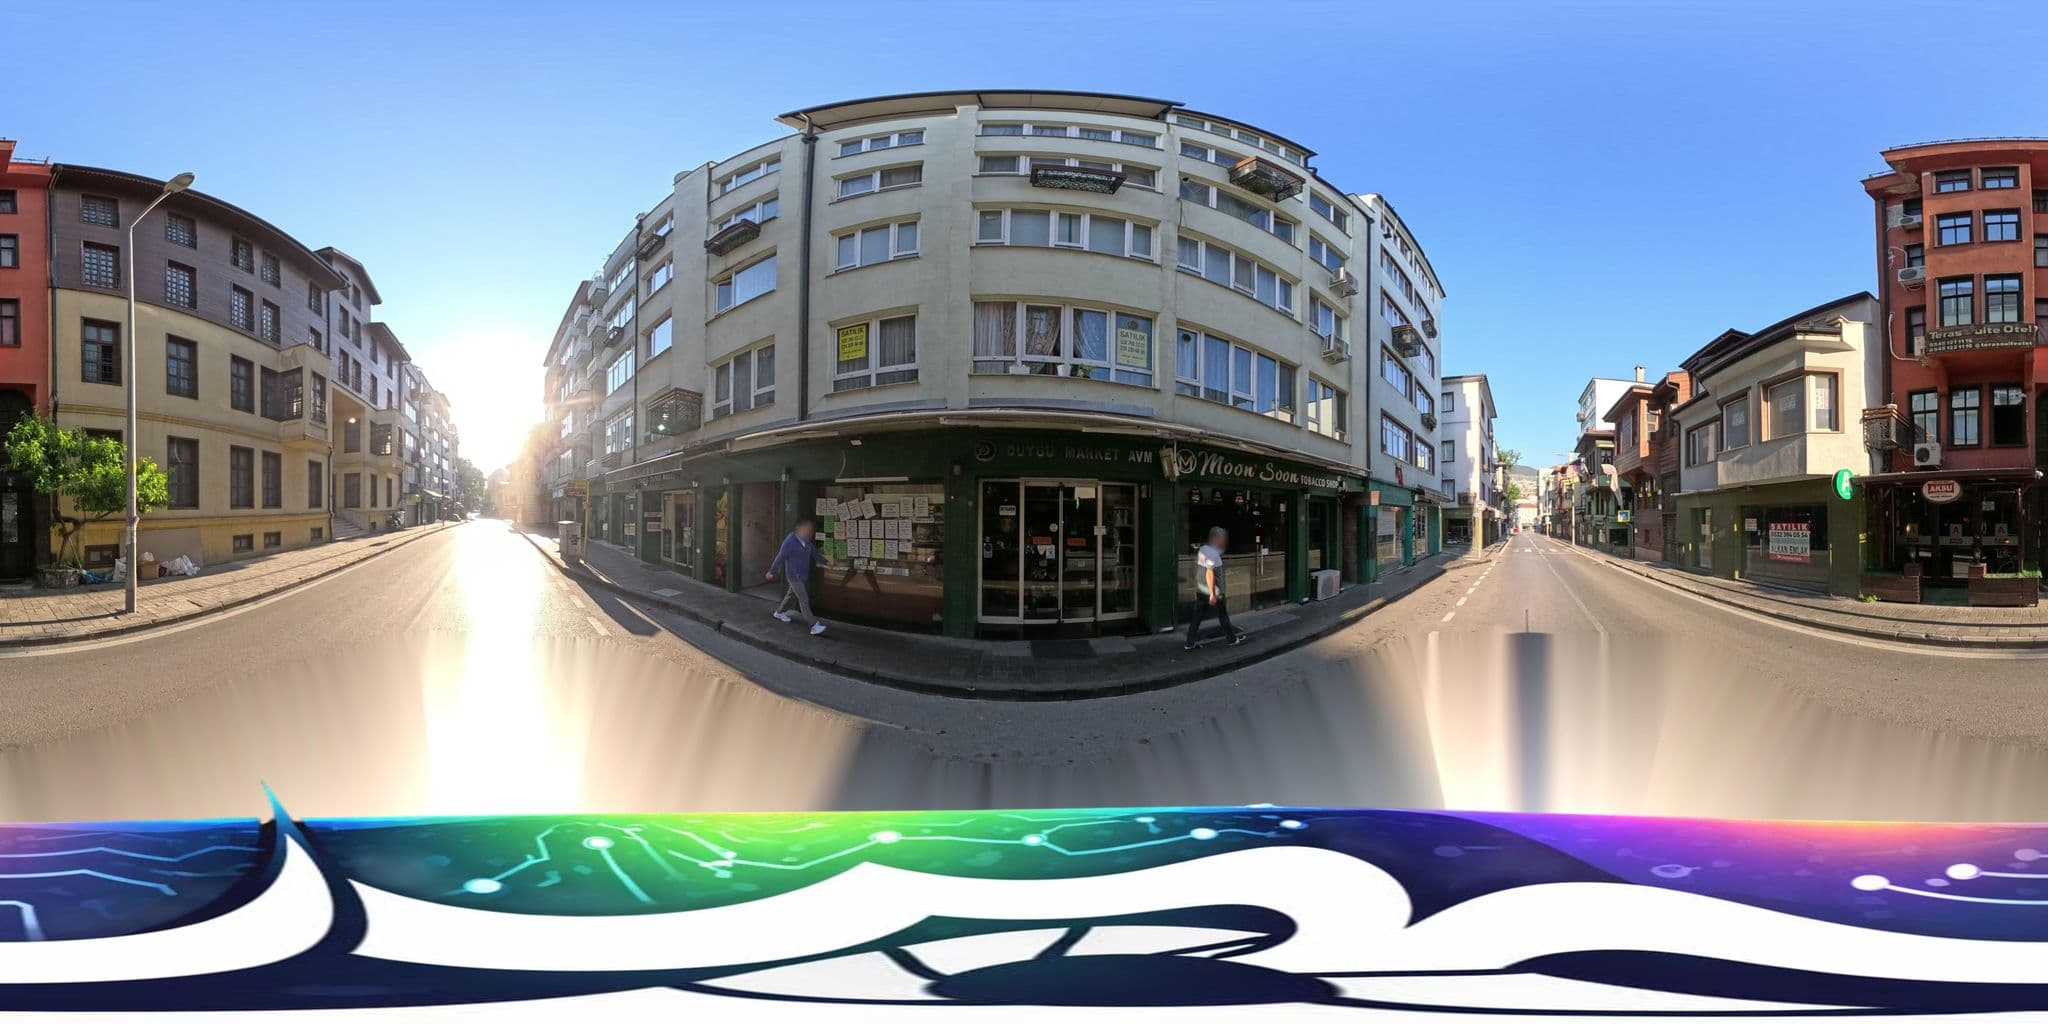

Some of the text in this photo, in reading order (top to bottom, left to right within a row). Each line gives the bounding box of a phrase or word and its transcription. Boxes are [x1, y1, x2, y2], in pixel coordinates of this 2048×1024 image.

[1928, 330, 1962, 339] Teras
[2003, 325, 2032, 333] Otel
[1065, 446, 1120, 461] MARKET
[1128, 448, 1153, 464] AVM
[1198, 451, 1339, 489] Moon Soon TOBACCO SHOP
[1929, 484, 1953, 492] AKSU
[1770, 523, 1808, 531] SATILIK
[1789, 545, 1808, 555] EMLAK
